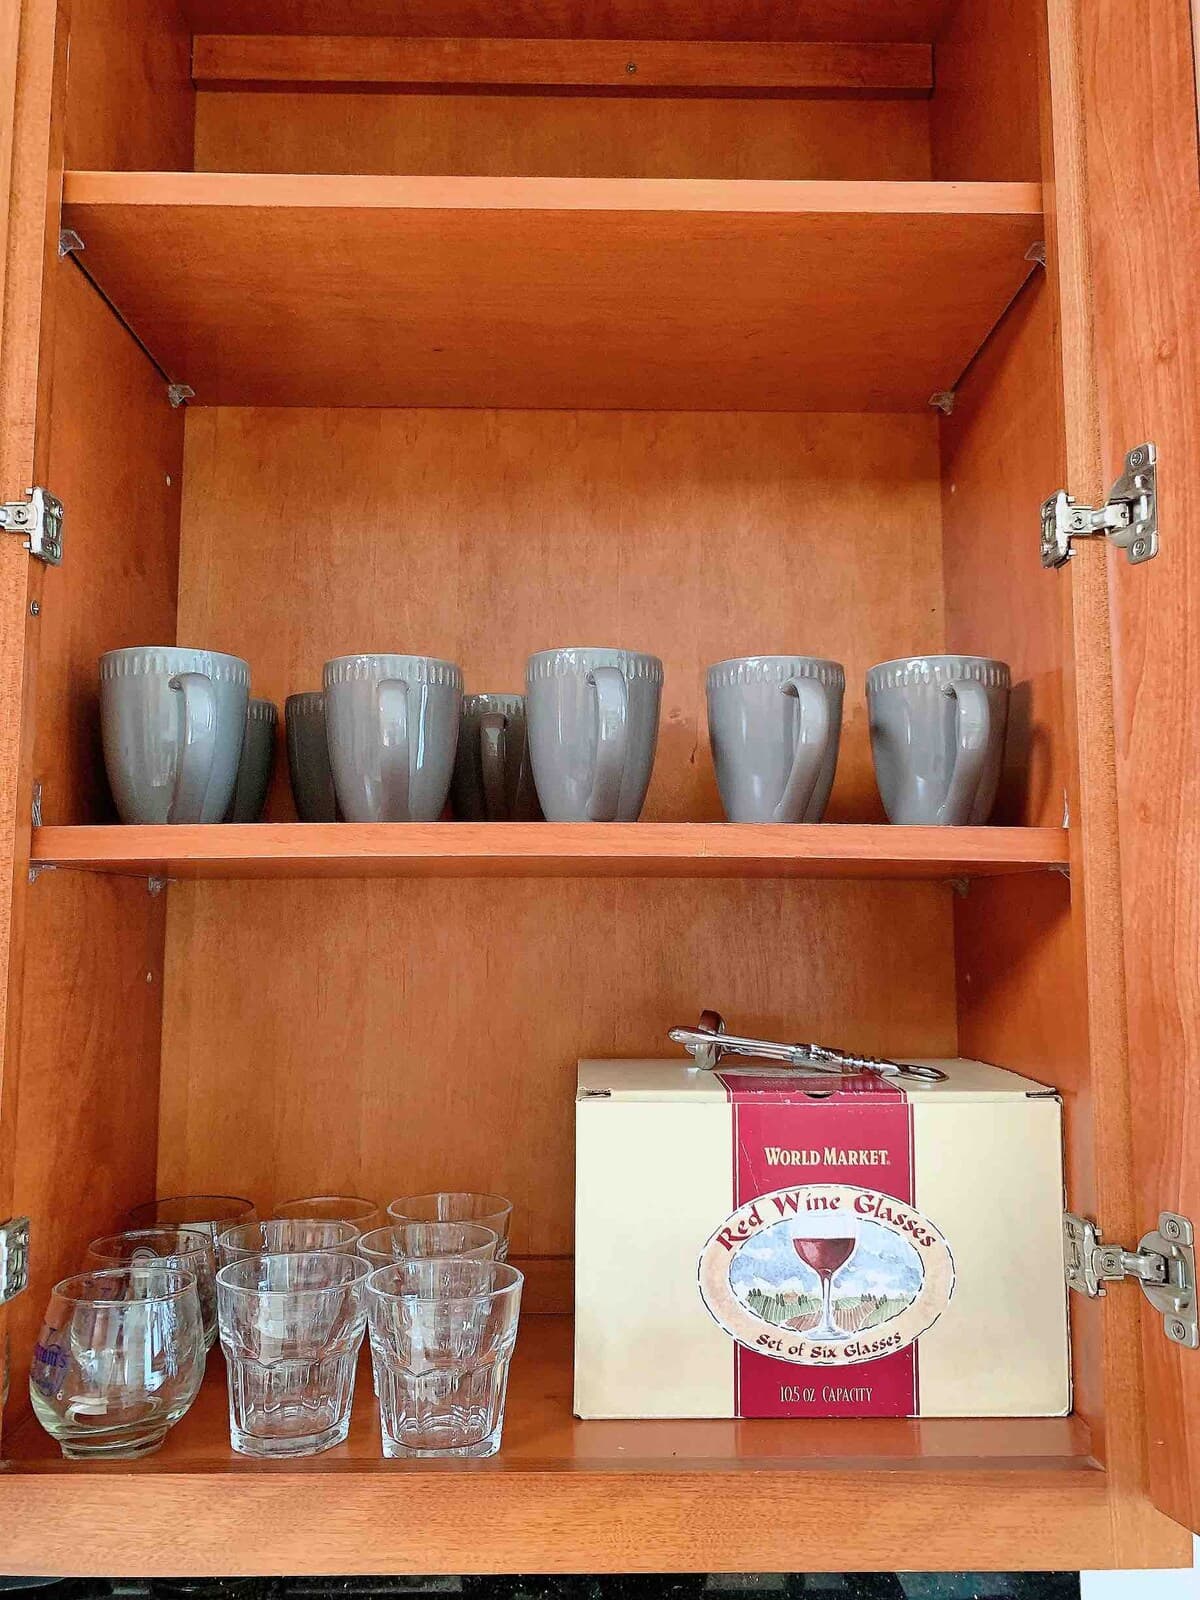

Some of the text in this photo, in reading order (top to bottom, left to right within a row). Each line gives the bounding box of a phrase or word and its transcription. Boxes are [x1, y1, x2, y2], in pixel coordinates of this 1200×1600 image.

[764, 1147, 821, 1166] WORLD
[715, 1190, 937, 1251] Red Wine Glasses
[755, 1331, 902, 1359] Set of Six Glasses
[822, 1385, 873, 1404] CAPACITY
